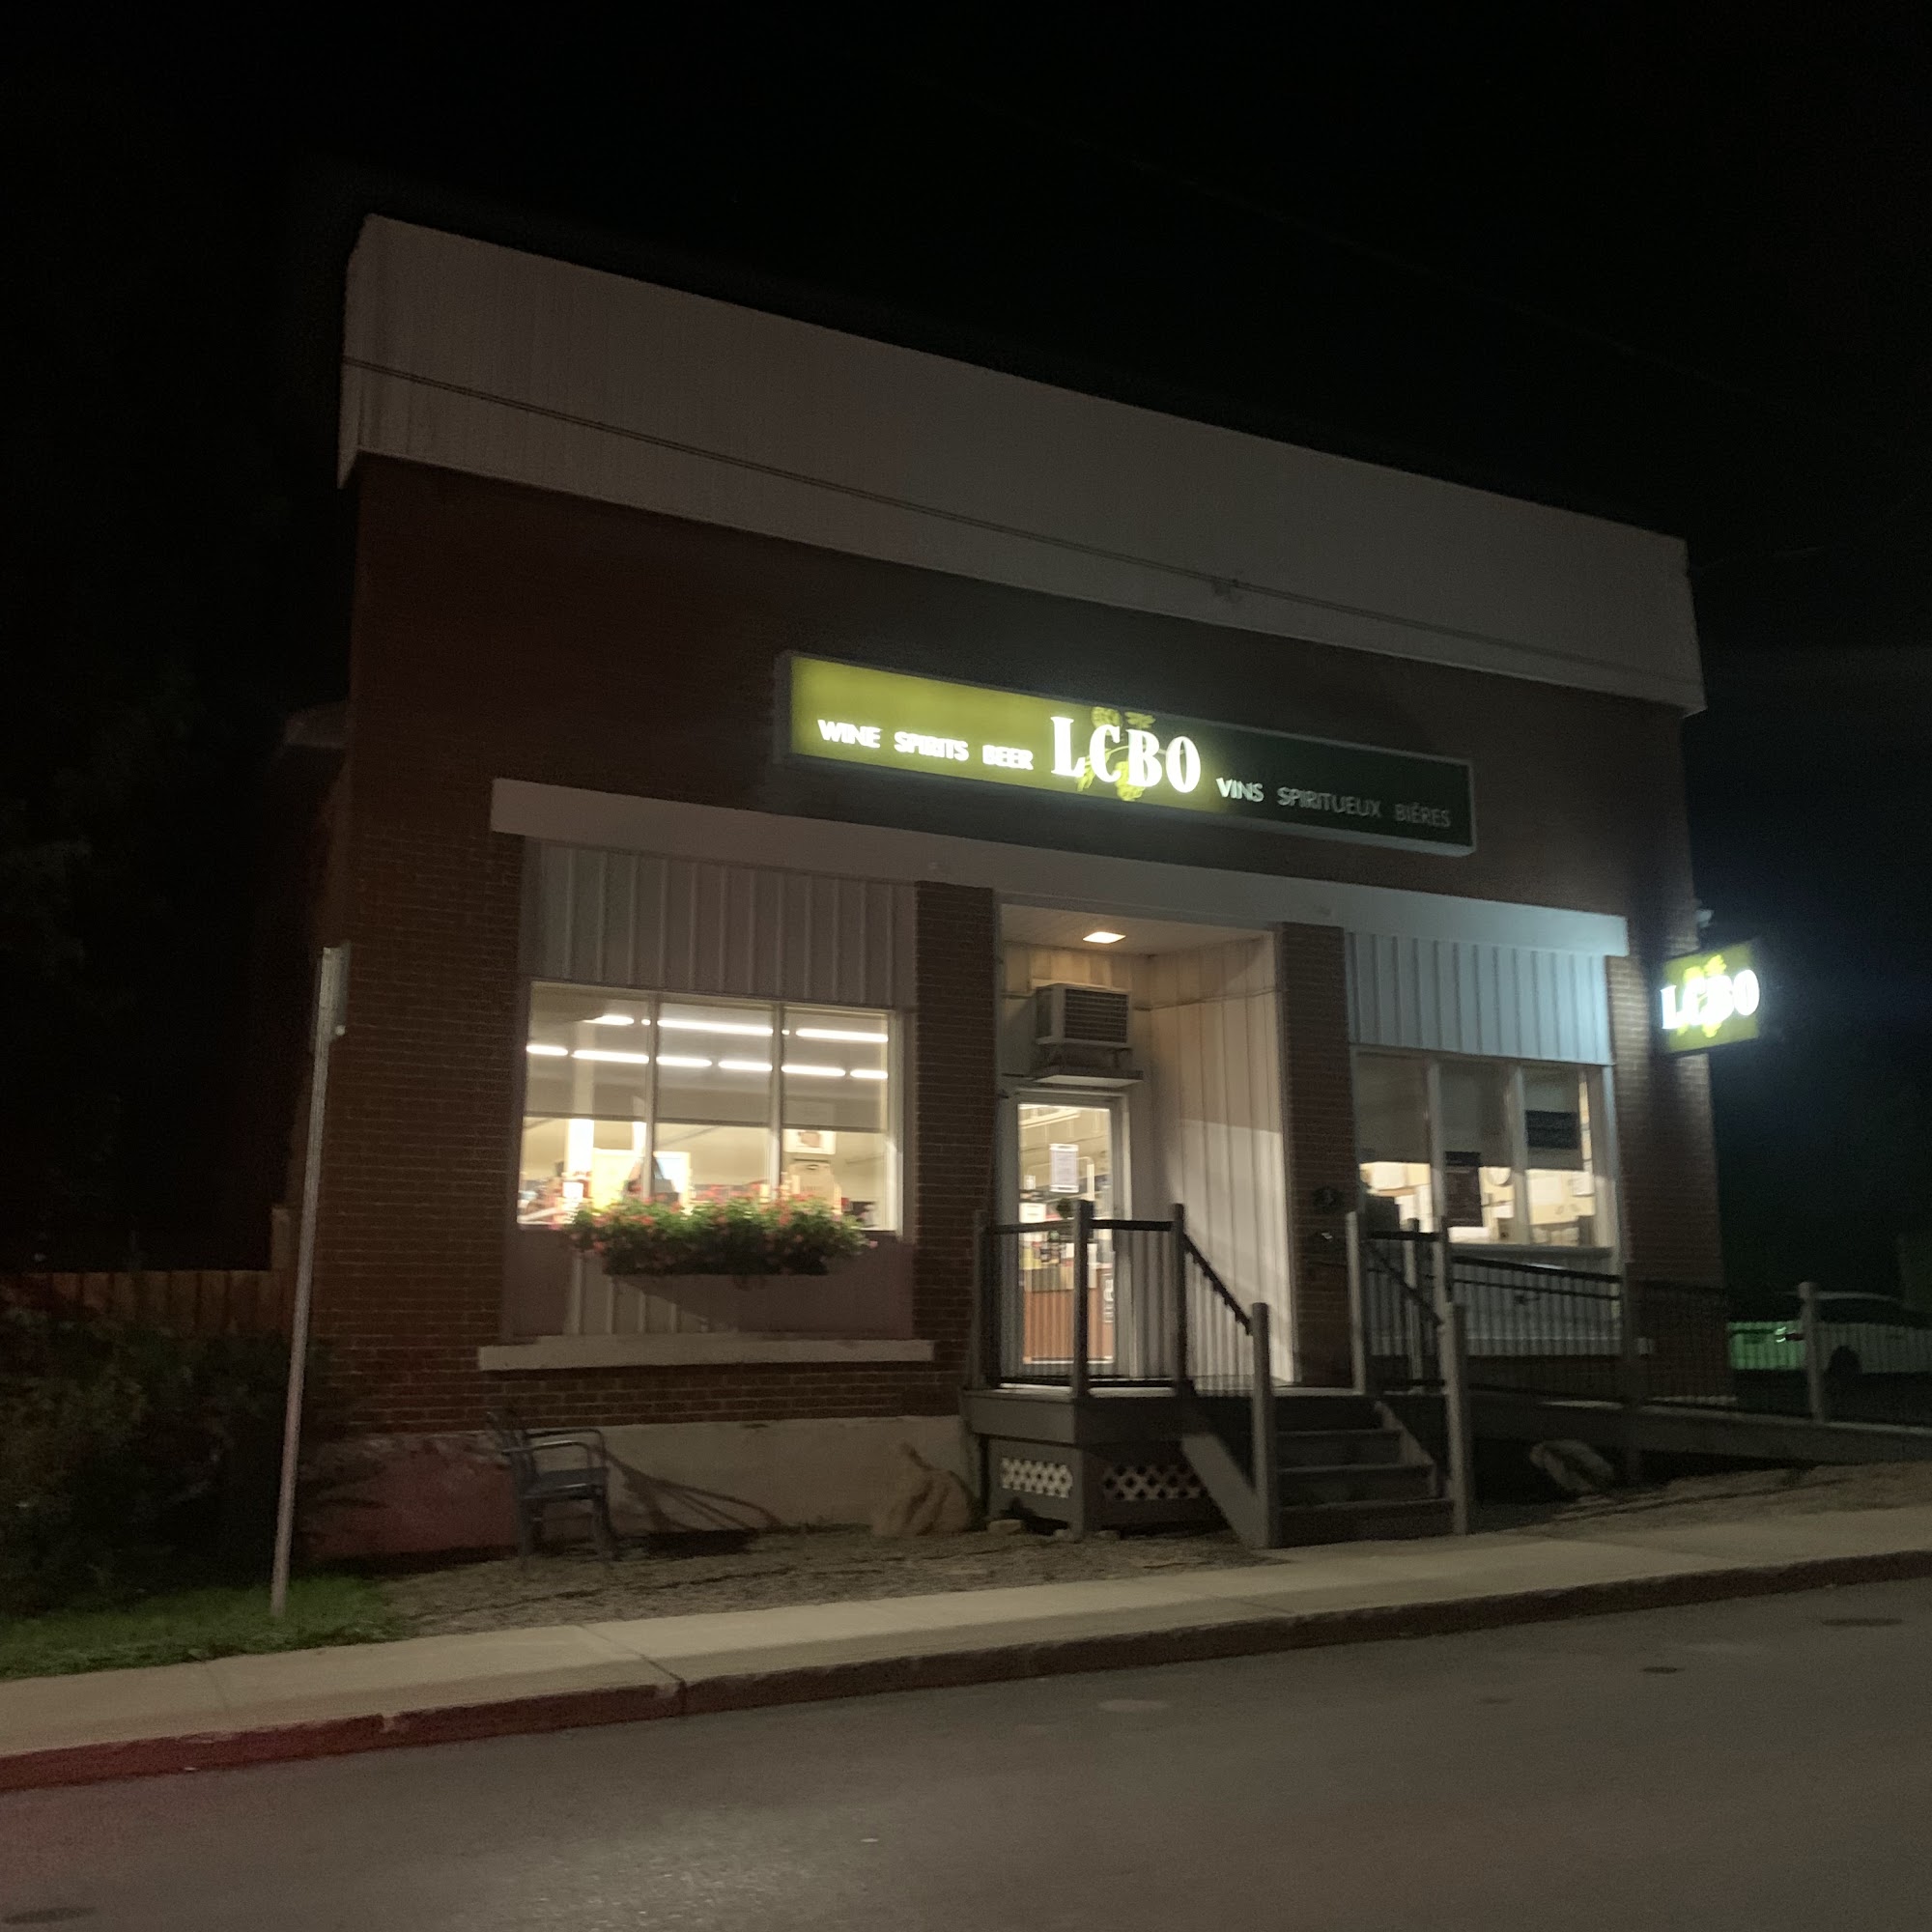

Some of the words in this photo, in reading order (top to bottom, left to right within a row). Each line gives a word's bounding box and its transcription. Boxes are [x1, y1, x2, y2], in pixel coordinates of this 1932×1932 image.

[818, 719, 880, 749] WINE
[894, 731, 969, 761] SPIRITS
[981, 744, 1034, 771] BEER
[1050, 716, 1201, 793] LCBO
[1215, 777, 1264, 803] VINS
[1276, 786, 1381, 818] SPIRITUEUX
[1660, 969, 1760, 1030] LCBO
